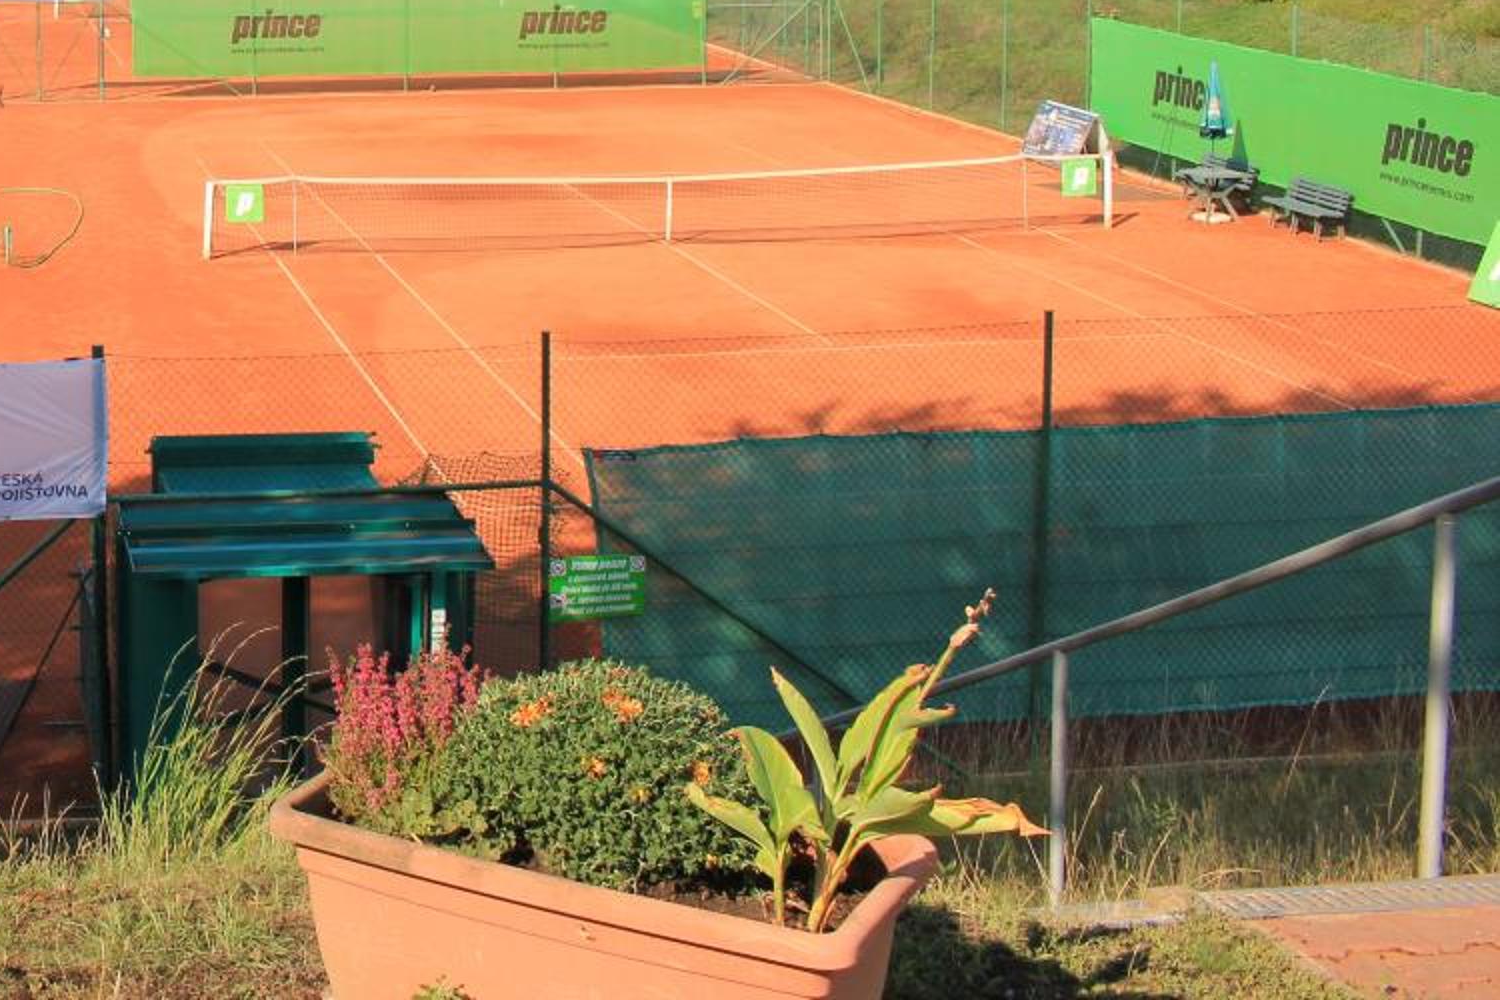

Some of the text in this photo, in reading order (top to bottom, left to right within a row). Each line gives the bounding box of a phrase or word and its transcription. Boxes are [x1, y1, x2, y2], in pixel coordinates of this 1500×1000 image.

[232, 9, 321, 44] prince
[519, 4, 608, 40] prince
[1153, 65, 1207, 112] princ
[1381, 117, 1474, 177] prince
